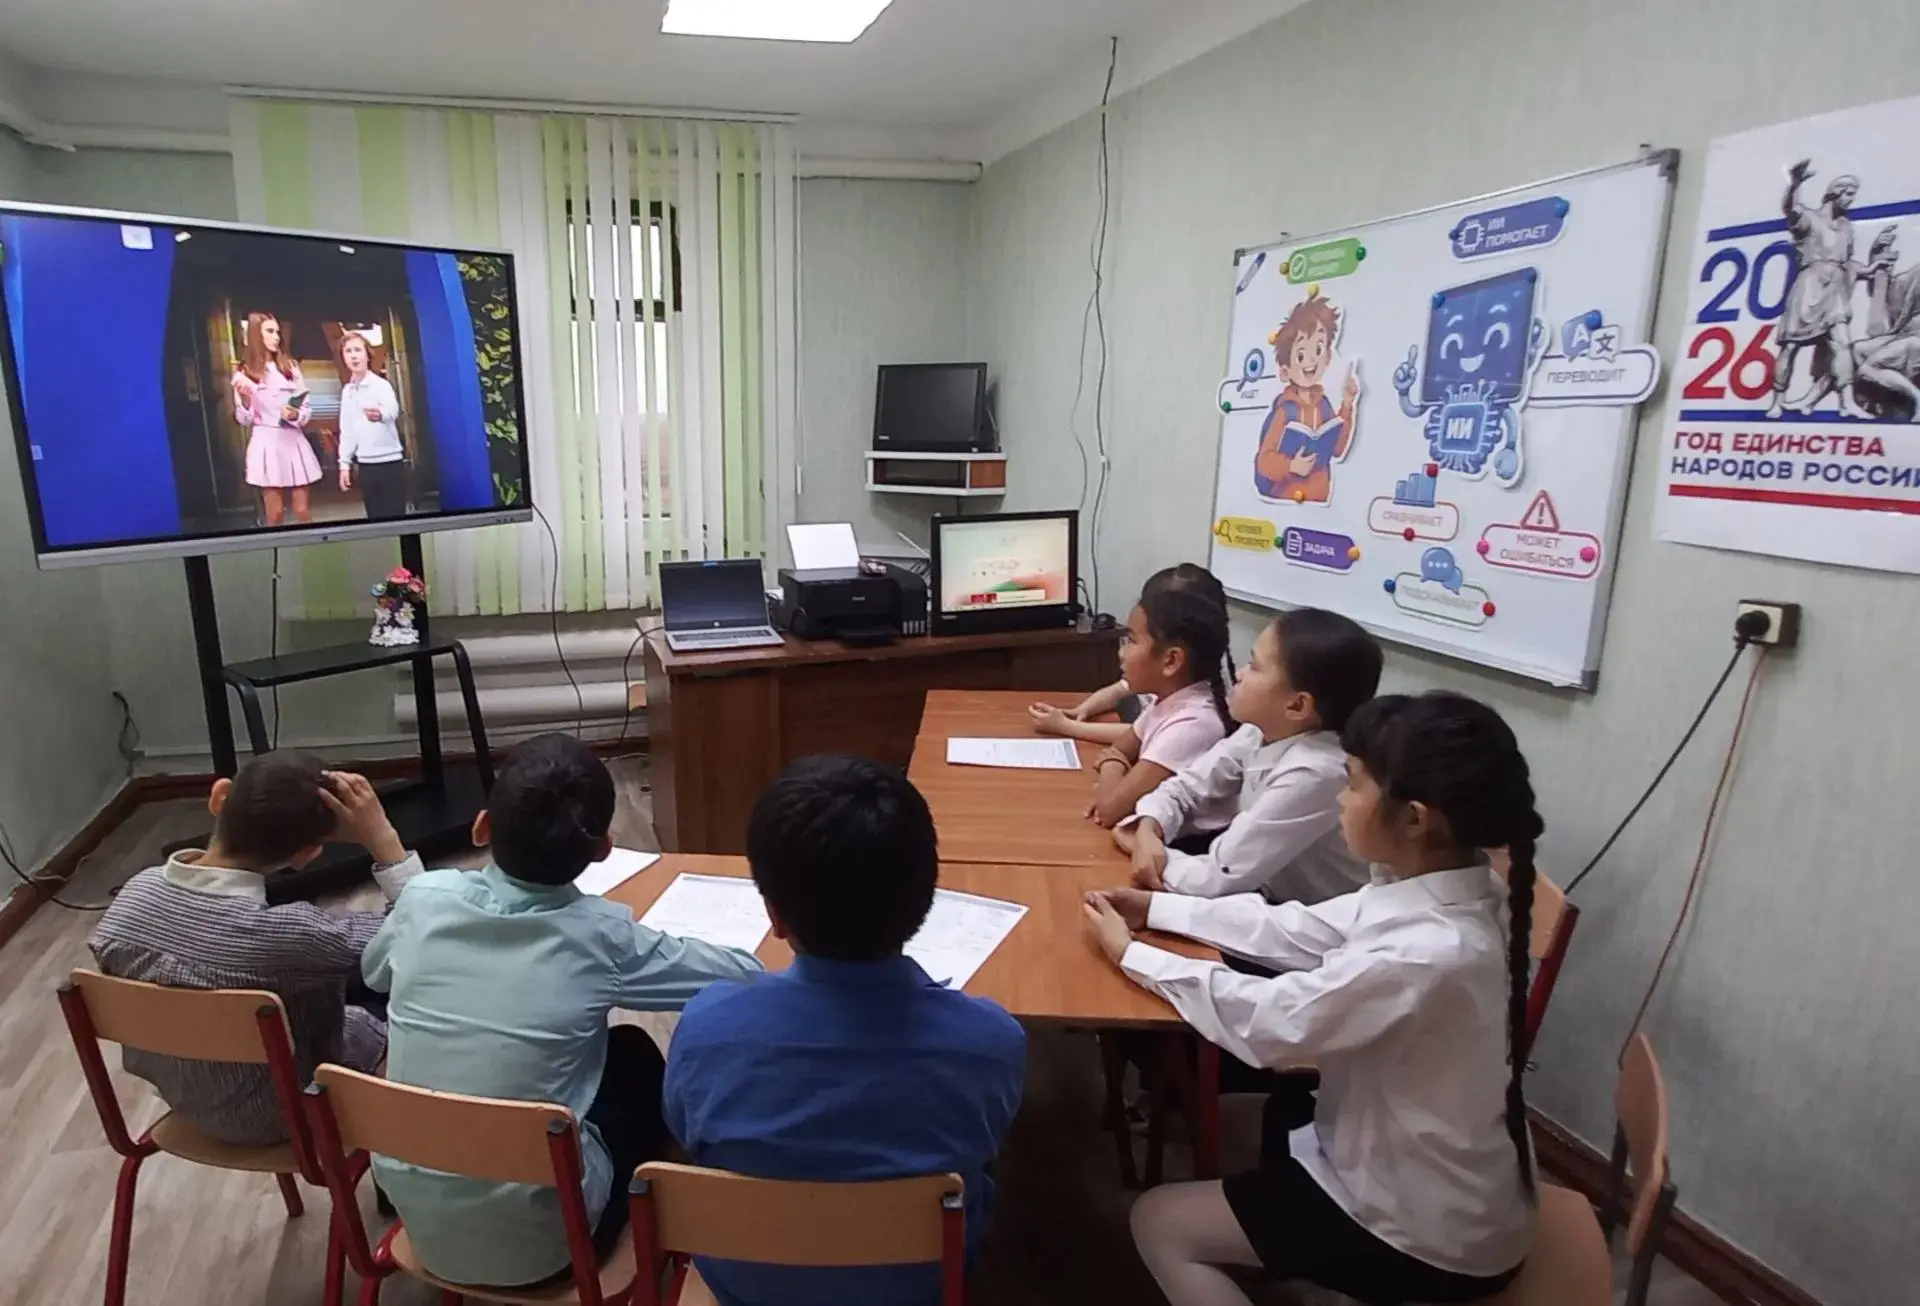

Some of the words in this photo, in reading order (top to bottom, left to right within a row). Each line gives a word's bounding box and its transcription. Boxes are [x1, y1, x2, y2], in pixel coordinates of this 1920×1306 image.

[1485, 224, 1550, 248] ПОМОГАЕТ
[1696, 240, 1799, 324] 20
[1682, 324, 1777, 401] 26
[1547, 368, 1626, 384] ПЕРЕВОДИТ
[1446, 417, 1474, 439] ИИ
[1674, 432, 1723, 453] ГОД
[1732, 432, 1886, 457] ЕДИНСТВА
[1671, 457, 1793, 481] НАРОДОВ
[1516, 534, 1561, 549] МОЖЕТ
[1500, 548, 1575, 569] ОШИБАТЬСЯ
